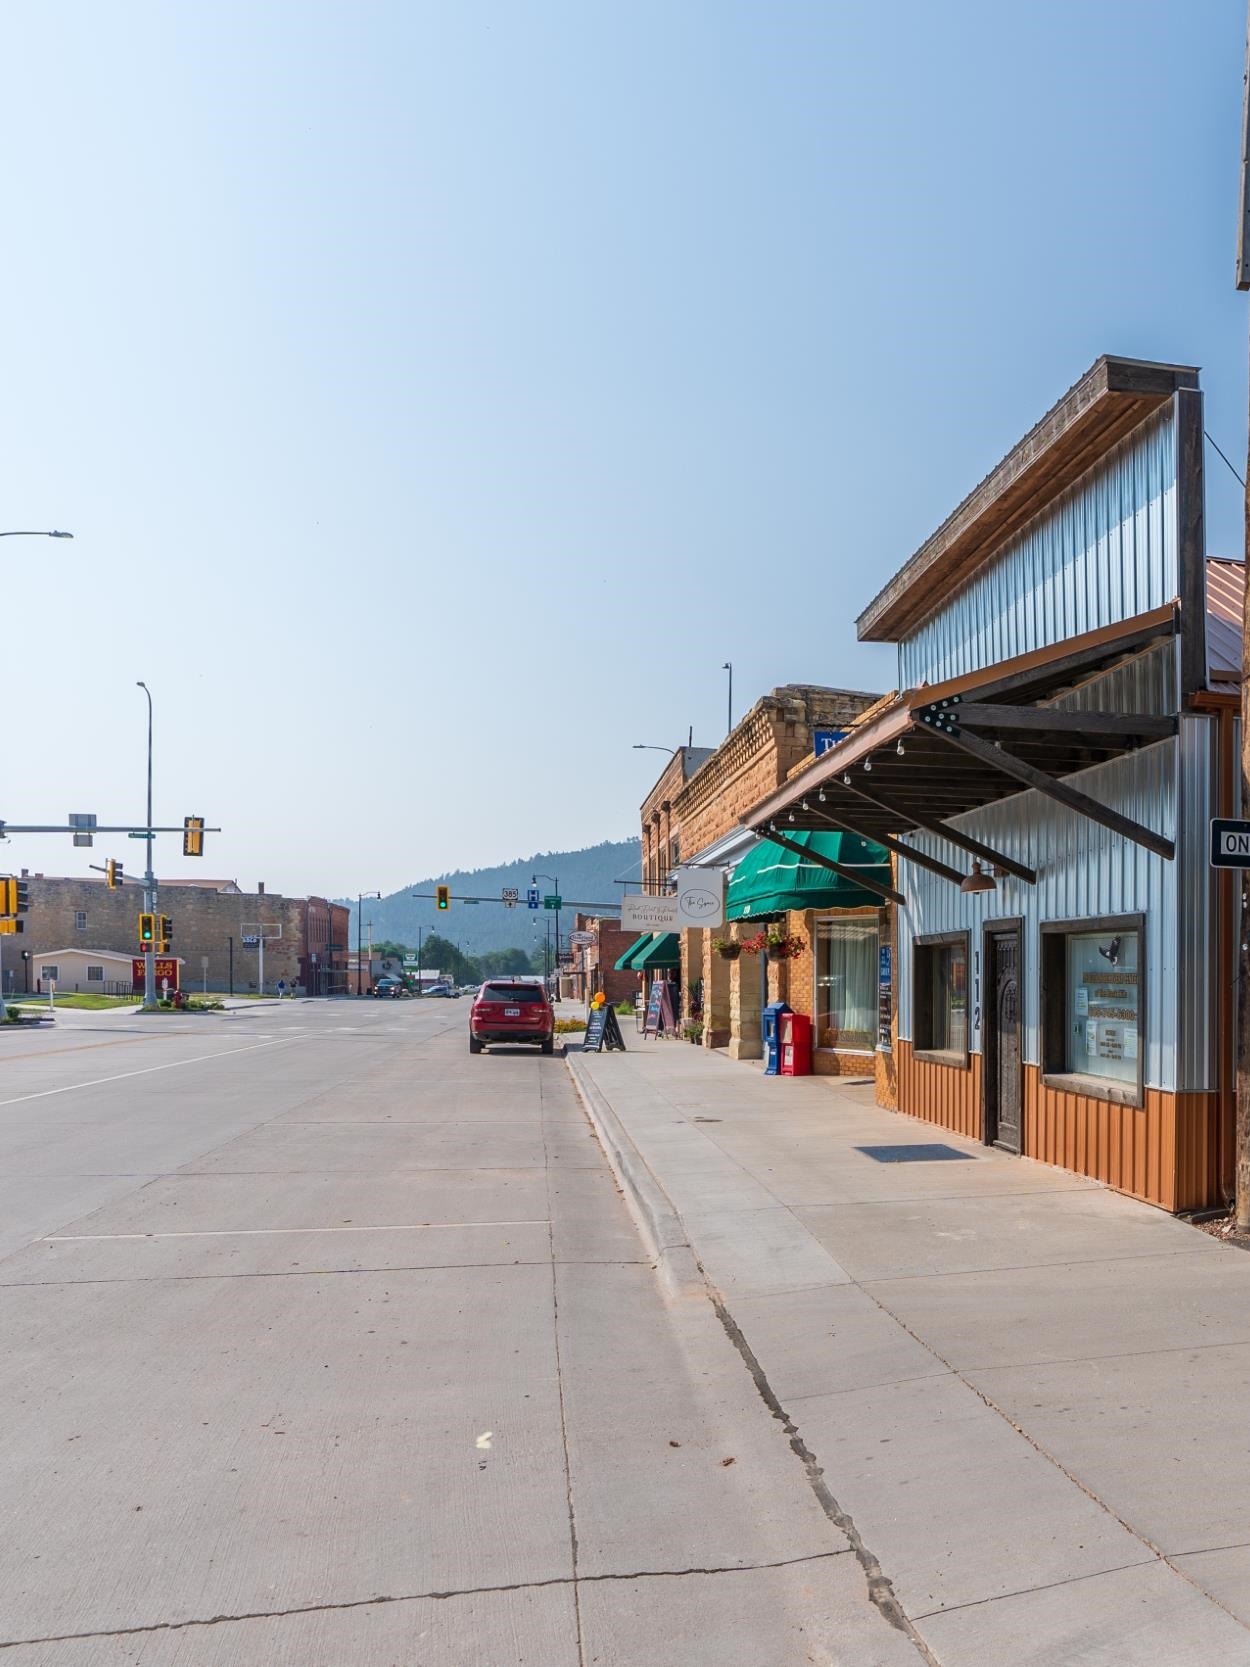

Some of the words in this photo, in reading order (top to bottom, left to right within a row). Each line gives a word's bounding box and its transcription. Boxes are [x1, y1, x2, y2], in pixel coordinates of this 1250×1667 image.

[503, 890, 517, 898] 385
[528, 890, 538, 901] H
[685, 896, 696, 909] The
[632, 913, 674, 922] BOUTIQUE
